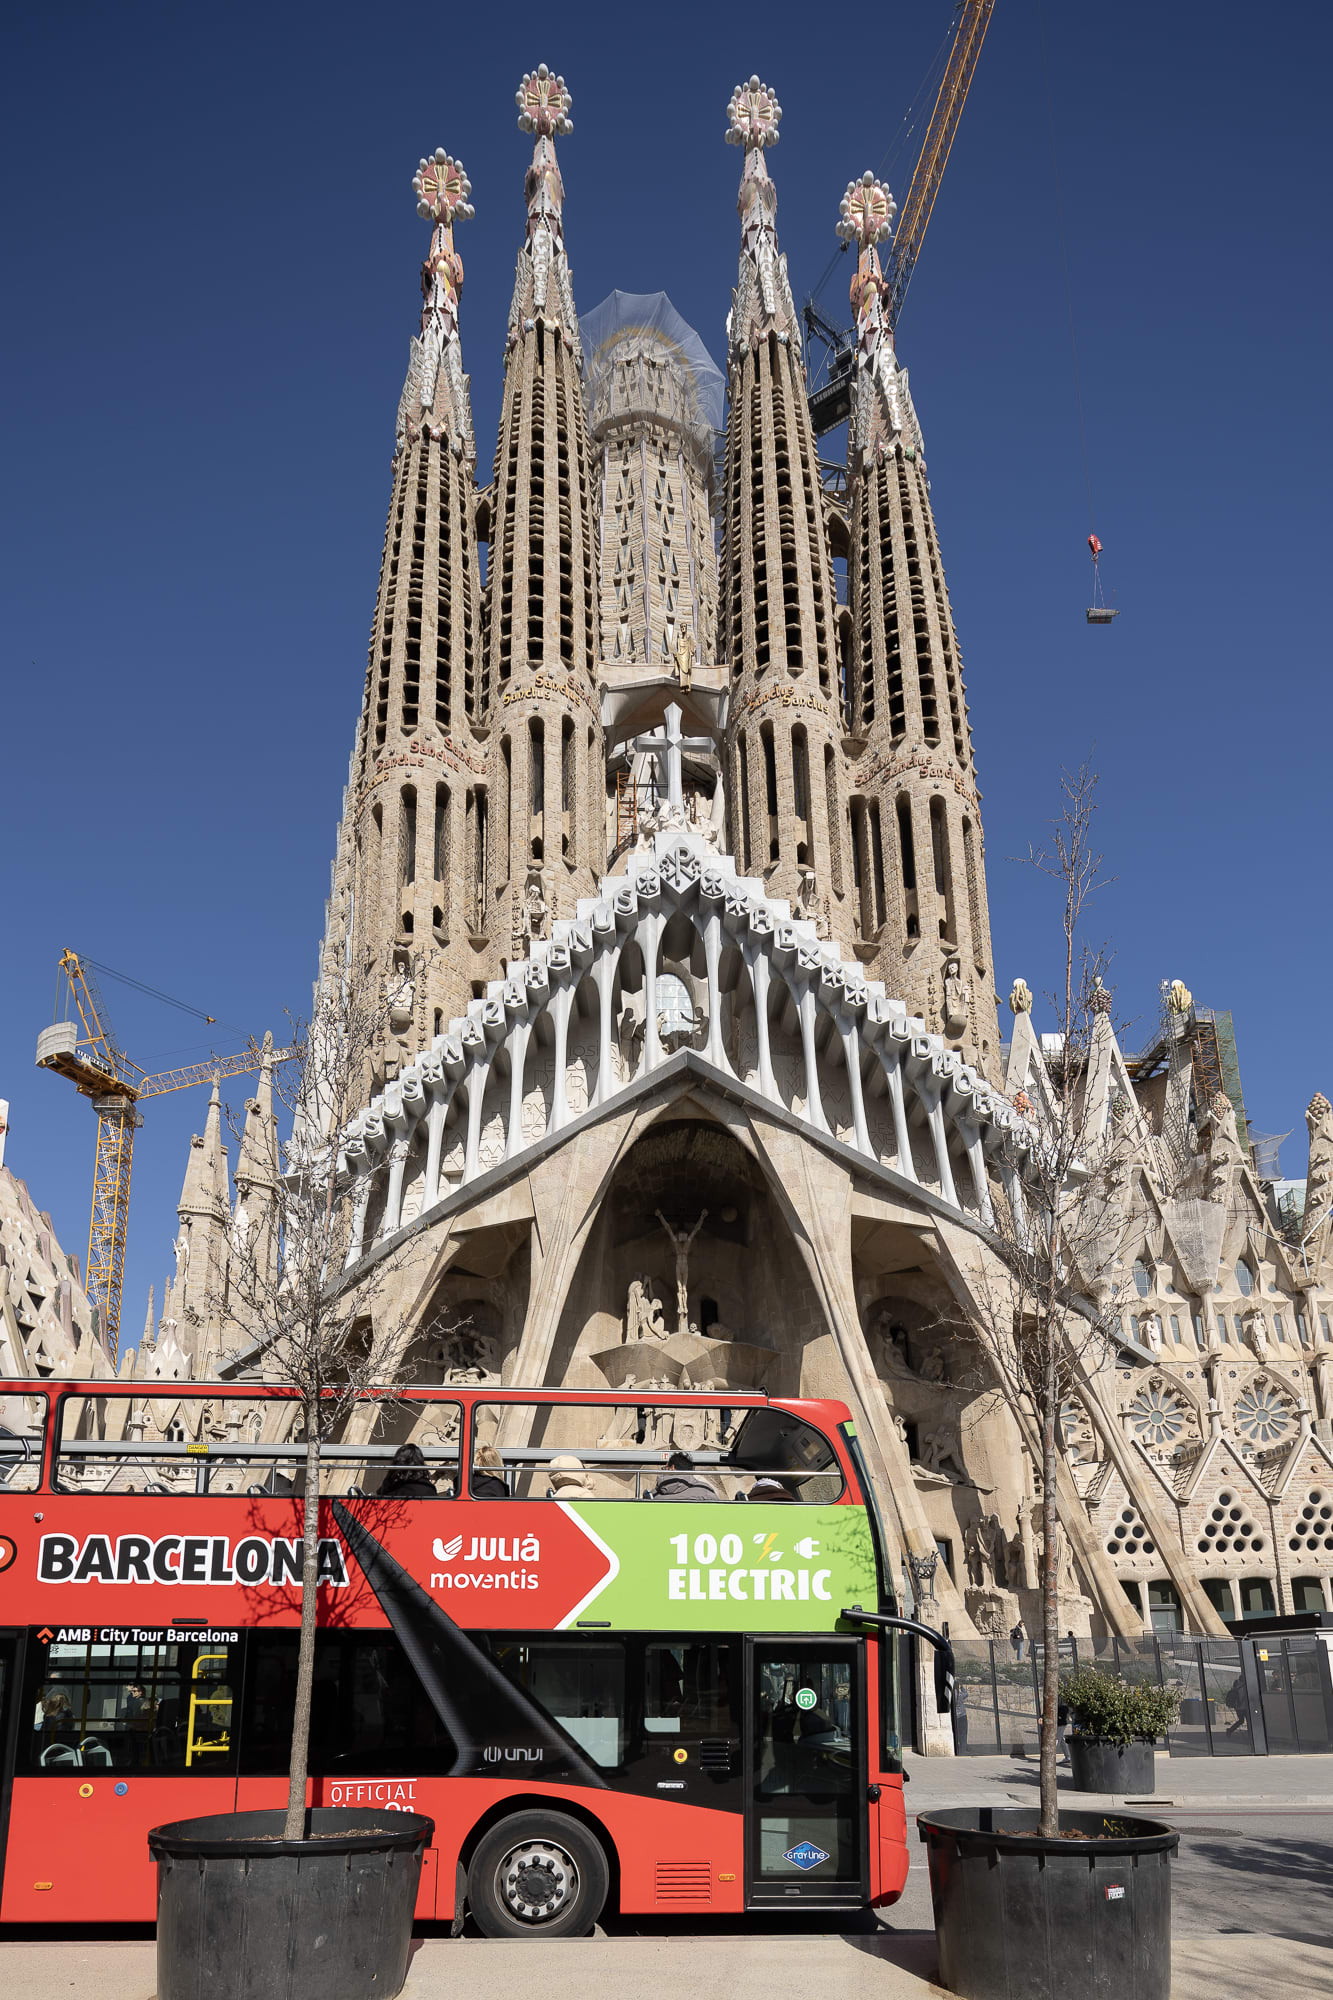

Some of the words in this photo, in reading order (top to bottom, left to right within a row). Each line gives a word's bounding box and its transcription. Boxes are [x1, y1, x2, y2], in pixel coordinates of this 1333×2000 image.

[503, 686, 551, 709] Sanctus
[535, 674, 581, 708] Sanctus
[748, 685, 795, 715] Sanctus
[781, 693, 830, 715] Sanctus
[376, 754, 425, 775] Sanctus
[409, 739, 459, 773] Sanctus
[882, 755, 933, 784] Sanctus
[38, 1535, 349, 1586] BARCELONA
[430, 1568, 539, 1590] moventis
[669, 1569, 832, 1600] ELECTRIC
[57, 1629, 91, 1642] AMB
[100, 1628, 129, 1645] City
[131, 1628, 163, 1642] Tour
[167, 1628, 238, 1643] Barcelona
[331, 1784, 416, 1802] OFFICIAL
